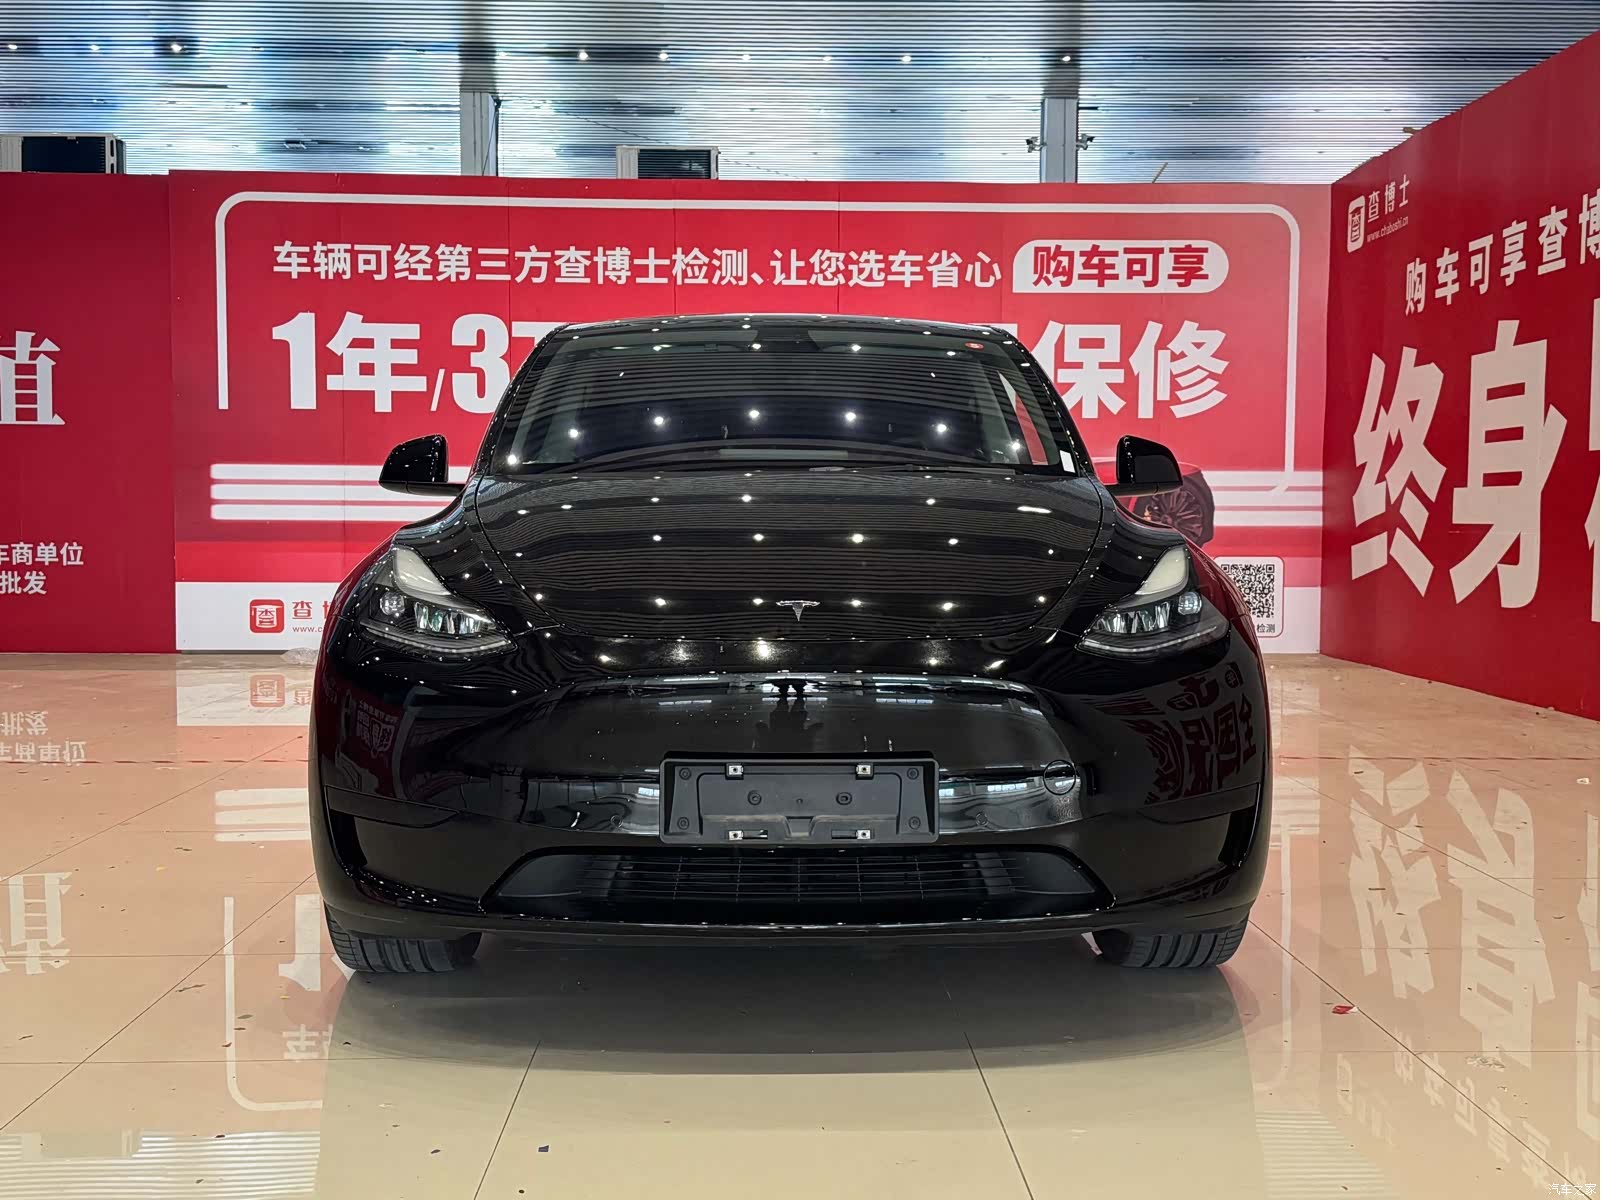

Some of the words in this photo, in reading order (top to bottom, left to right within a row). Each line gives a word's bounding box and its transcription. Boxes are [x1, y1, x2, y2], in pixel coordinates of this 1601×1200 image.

[1368, 174, 1410, 223] 查博士
[273, 241, 1002, 289] 车辆可经第三方查博士检测、让您选车省心
[1032, 244, 1211, 288] 购车可享
[272, 311, 570, 414] 1年/3
